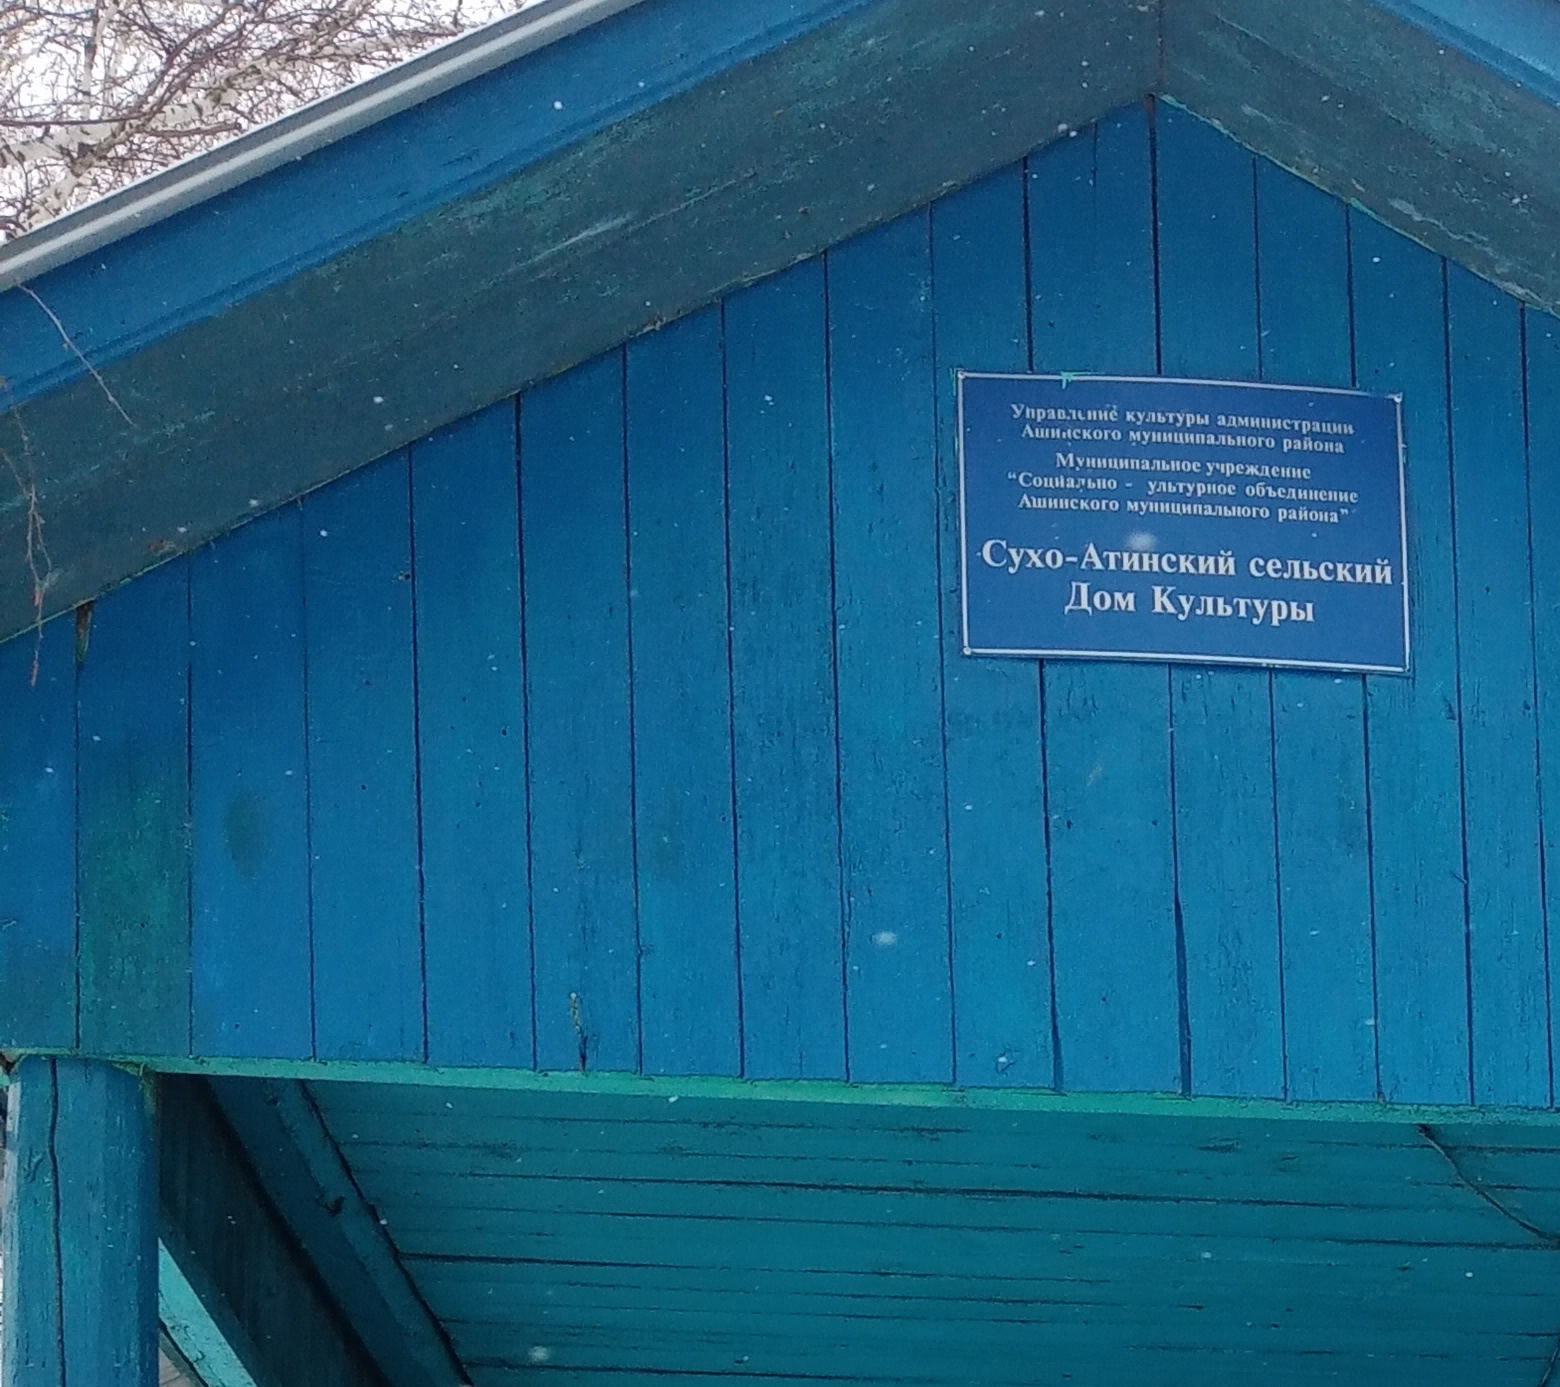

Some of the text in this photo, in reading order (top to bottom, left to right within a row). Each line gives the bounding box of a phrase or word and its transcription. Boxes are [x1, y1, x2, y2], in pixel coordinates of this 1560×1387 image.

[1125, 410, 1210, 428] культуры
[1217, 415, 1355, 436] администрации
[1021, 423, 1345, 454] Ашинского муниципального района
[1056, 453, 1311, 480] Муниципальное учреждение
[1018, 493, 1119, 513] Ашинского
[1126, 500, 1271, 521] муниципального
[1245, 485, 1359, 504] объединение
[981, 538, 1394, 585] Сухо-Атинский сельский
[1064, 581, 1316, 627] Дом Культуры
